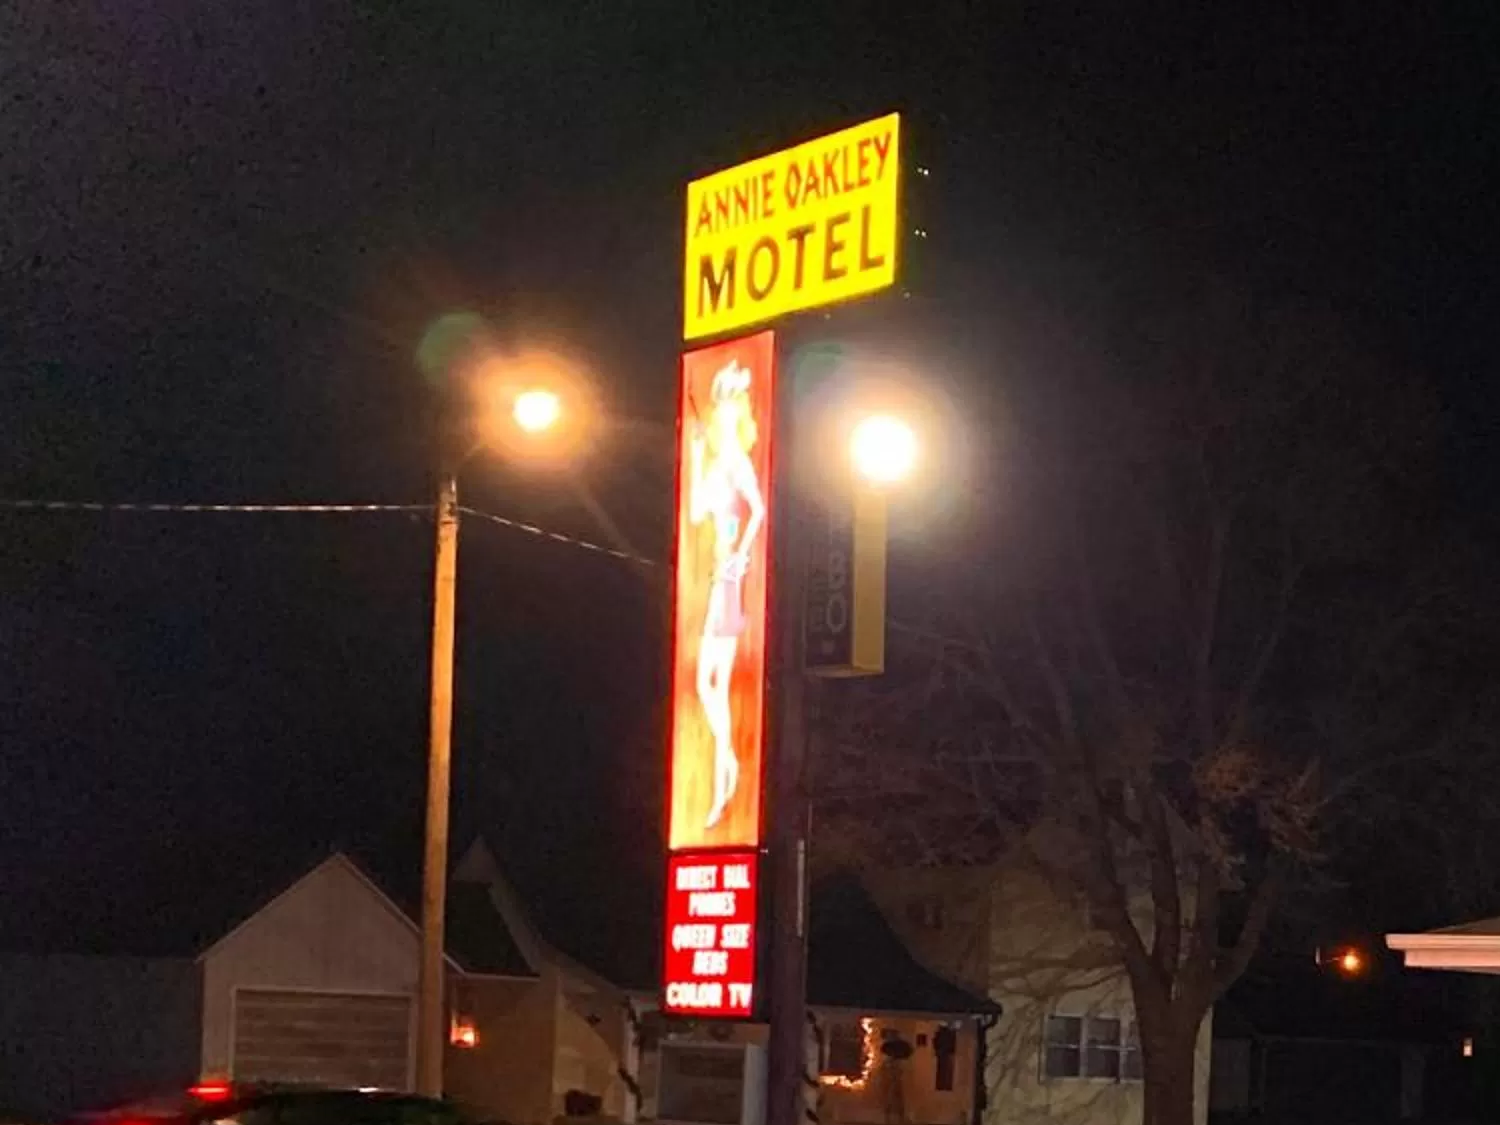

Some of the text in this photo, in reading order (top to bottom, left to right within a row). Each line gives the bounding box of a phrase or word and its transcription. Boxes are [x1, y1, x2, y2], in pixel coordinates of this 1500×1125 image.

[694, 132, 891, 237] ANNIE OAKLEY
[697, 204, 884, 319] MOTEL
[667, 982, 752, 1008] COLOR TV
